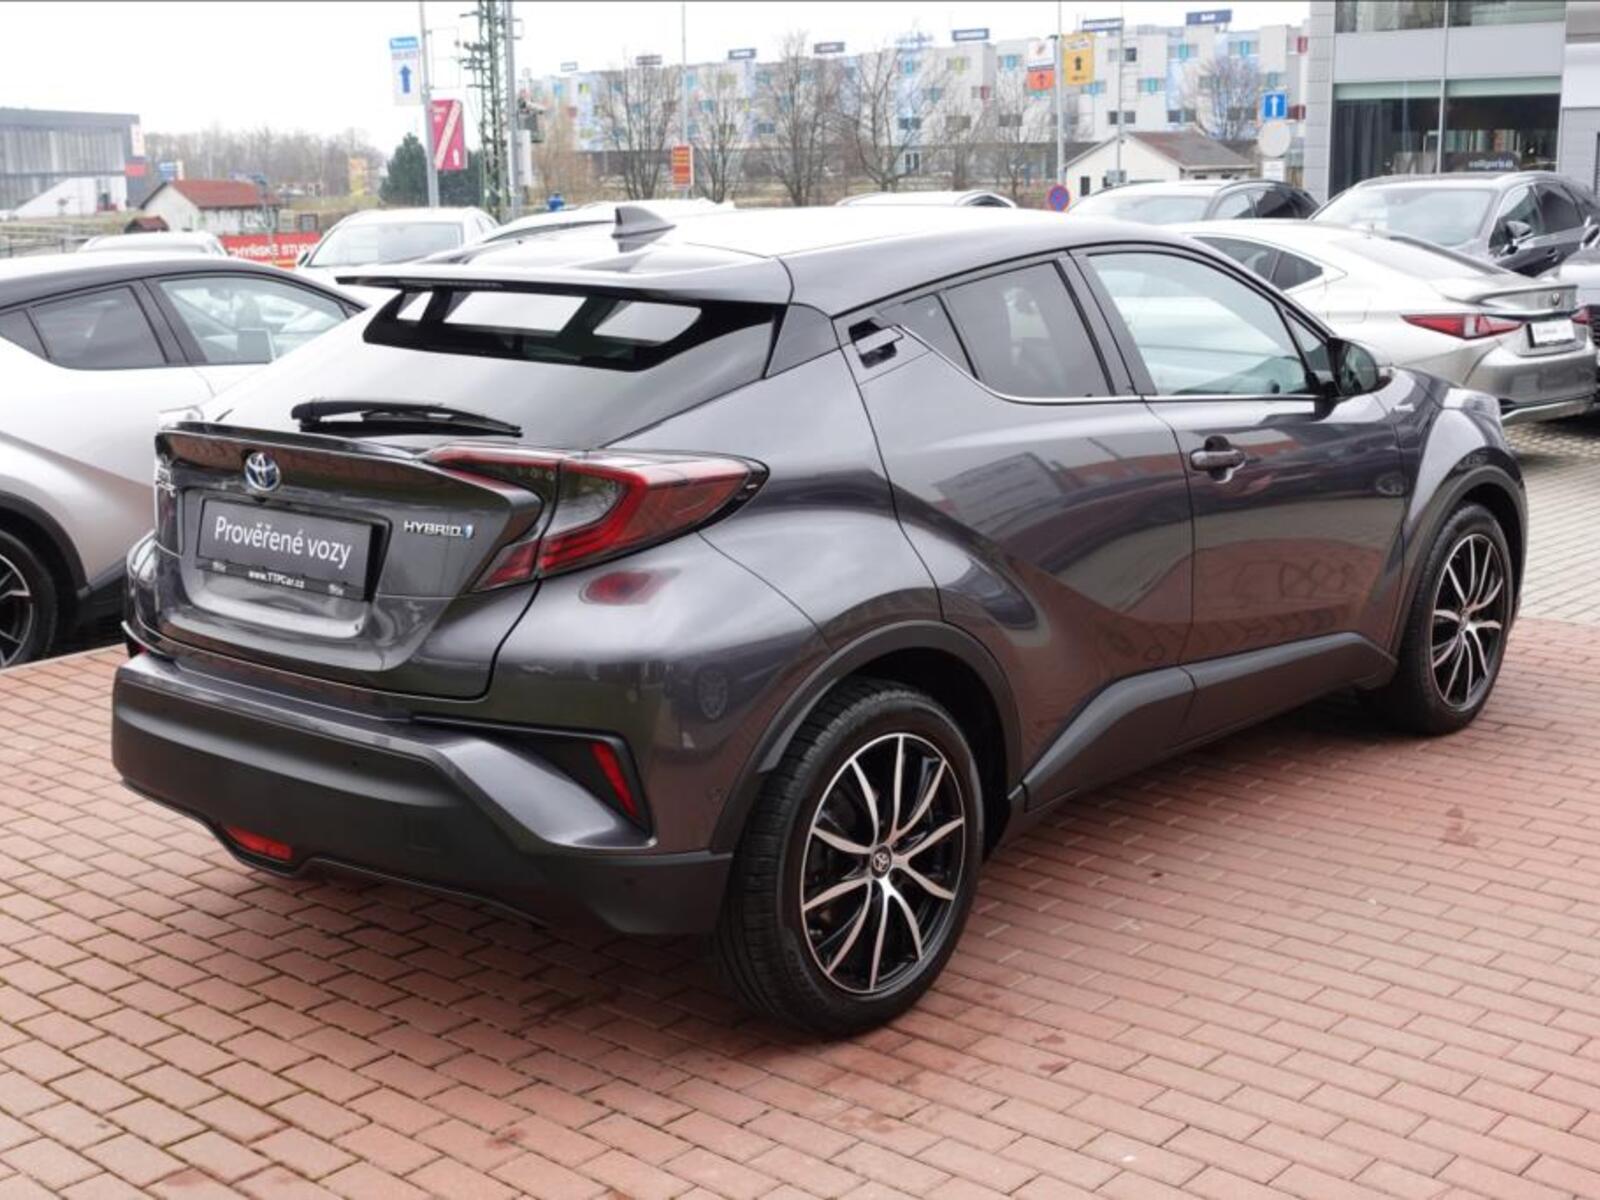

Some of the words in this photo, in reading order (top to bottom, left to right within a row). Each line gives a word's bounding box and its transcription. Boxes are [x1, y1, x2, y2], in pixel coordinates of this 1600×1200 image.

[214, 515, 303, 555] Prověřené
[307, 537, 352, 570] vozy
[404, 520, 463, 537] HYBRID
